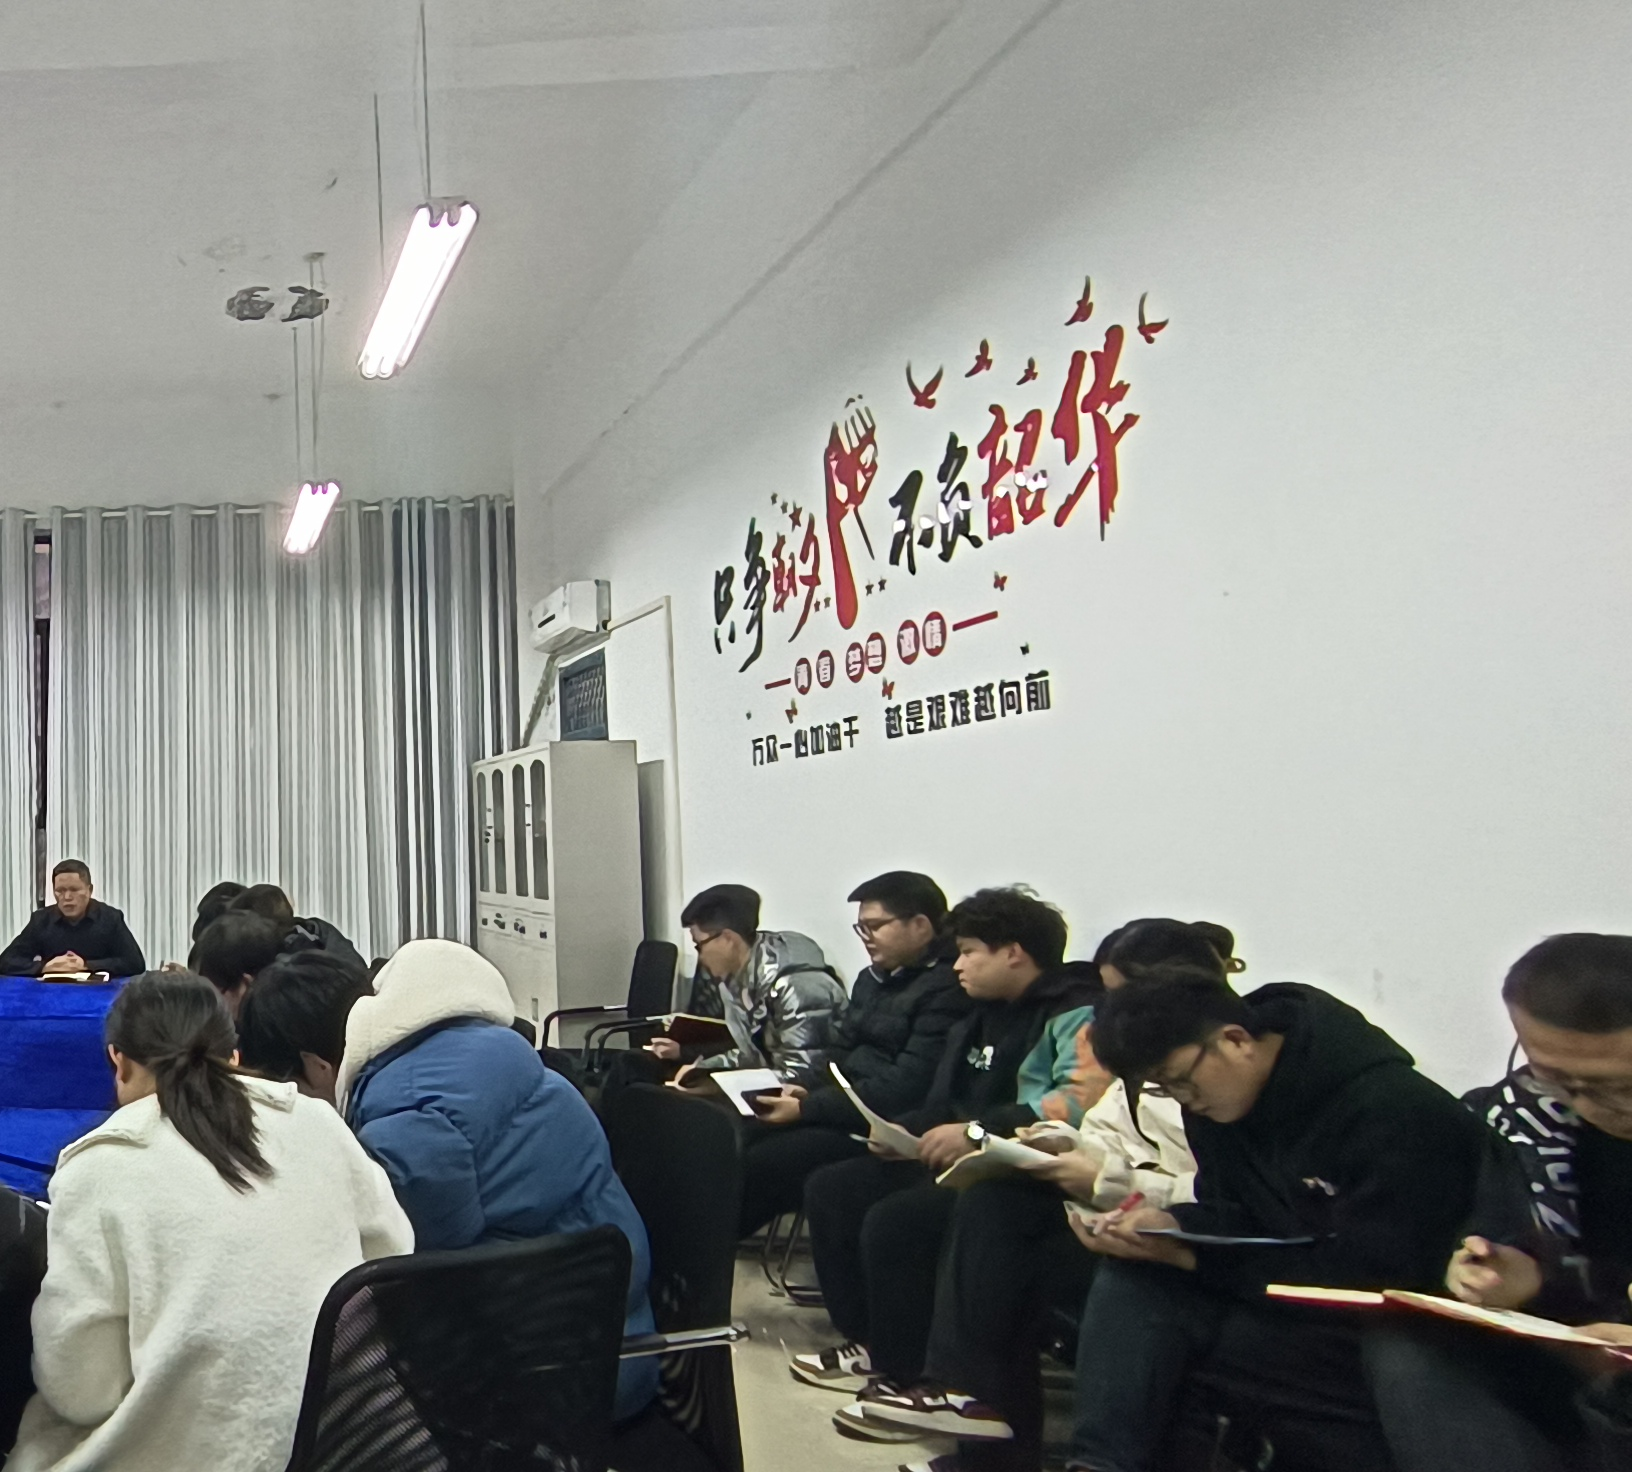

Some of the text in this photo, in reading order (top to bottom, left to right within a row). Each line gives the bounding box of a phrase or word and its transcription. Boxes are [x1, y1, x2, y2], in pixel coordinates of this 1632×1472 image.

[884, 669, 1052, 740] 越是艰难越向前
